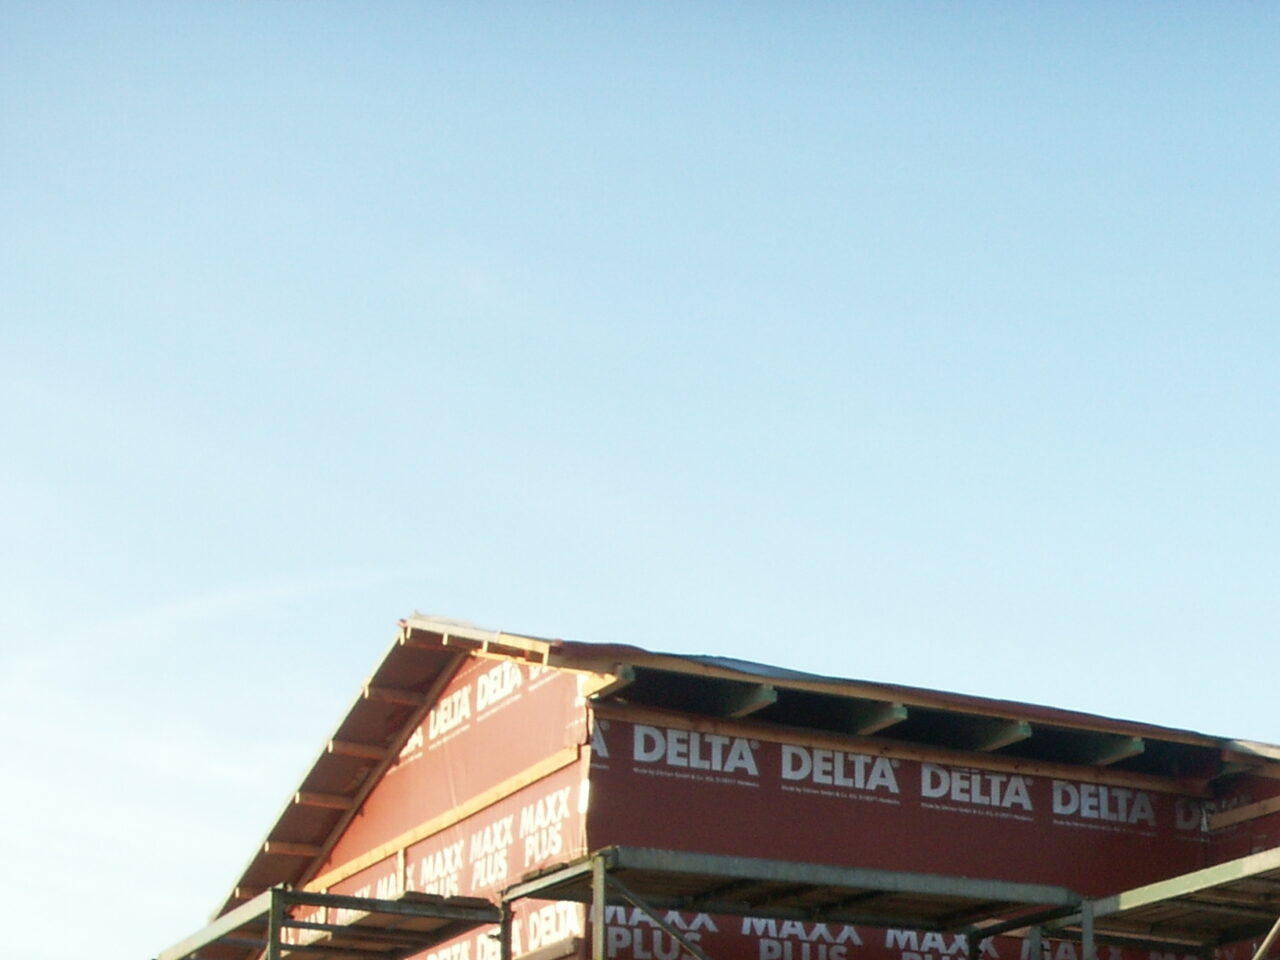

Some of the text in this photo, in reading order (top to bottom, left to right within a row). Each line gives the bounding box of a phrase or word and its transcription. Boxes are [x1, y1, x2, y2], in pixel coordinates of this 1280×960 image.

[633, 724, 759, 776] DELTA
[781, 744, 899, 793] DELTA
[920, 762, 1033, 811] DELTA
[1052, 780, 1156, 826] DELTA
[421, 840, 464, 886] MAXX
[469, 814, 513, 864] MAXX
[520, 787, 571, 839] MAXX
[472, 850, 508, 891] PLUS
[525, 822, 562, 868] PLUS
[528, 901, 580, 960] DELTA
[741, 917, 863, 947] MAXX
